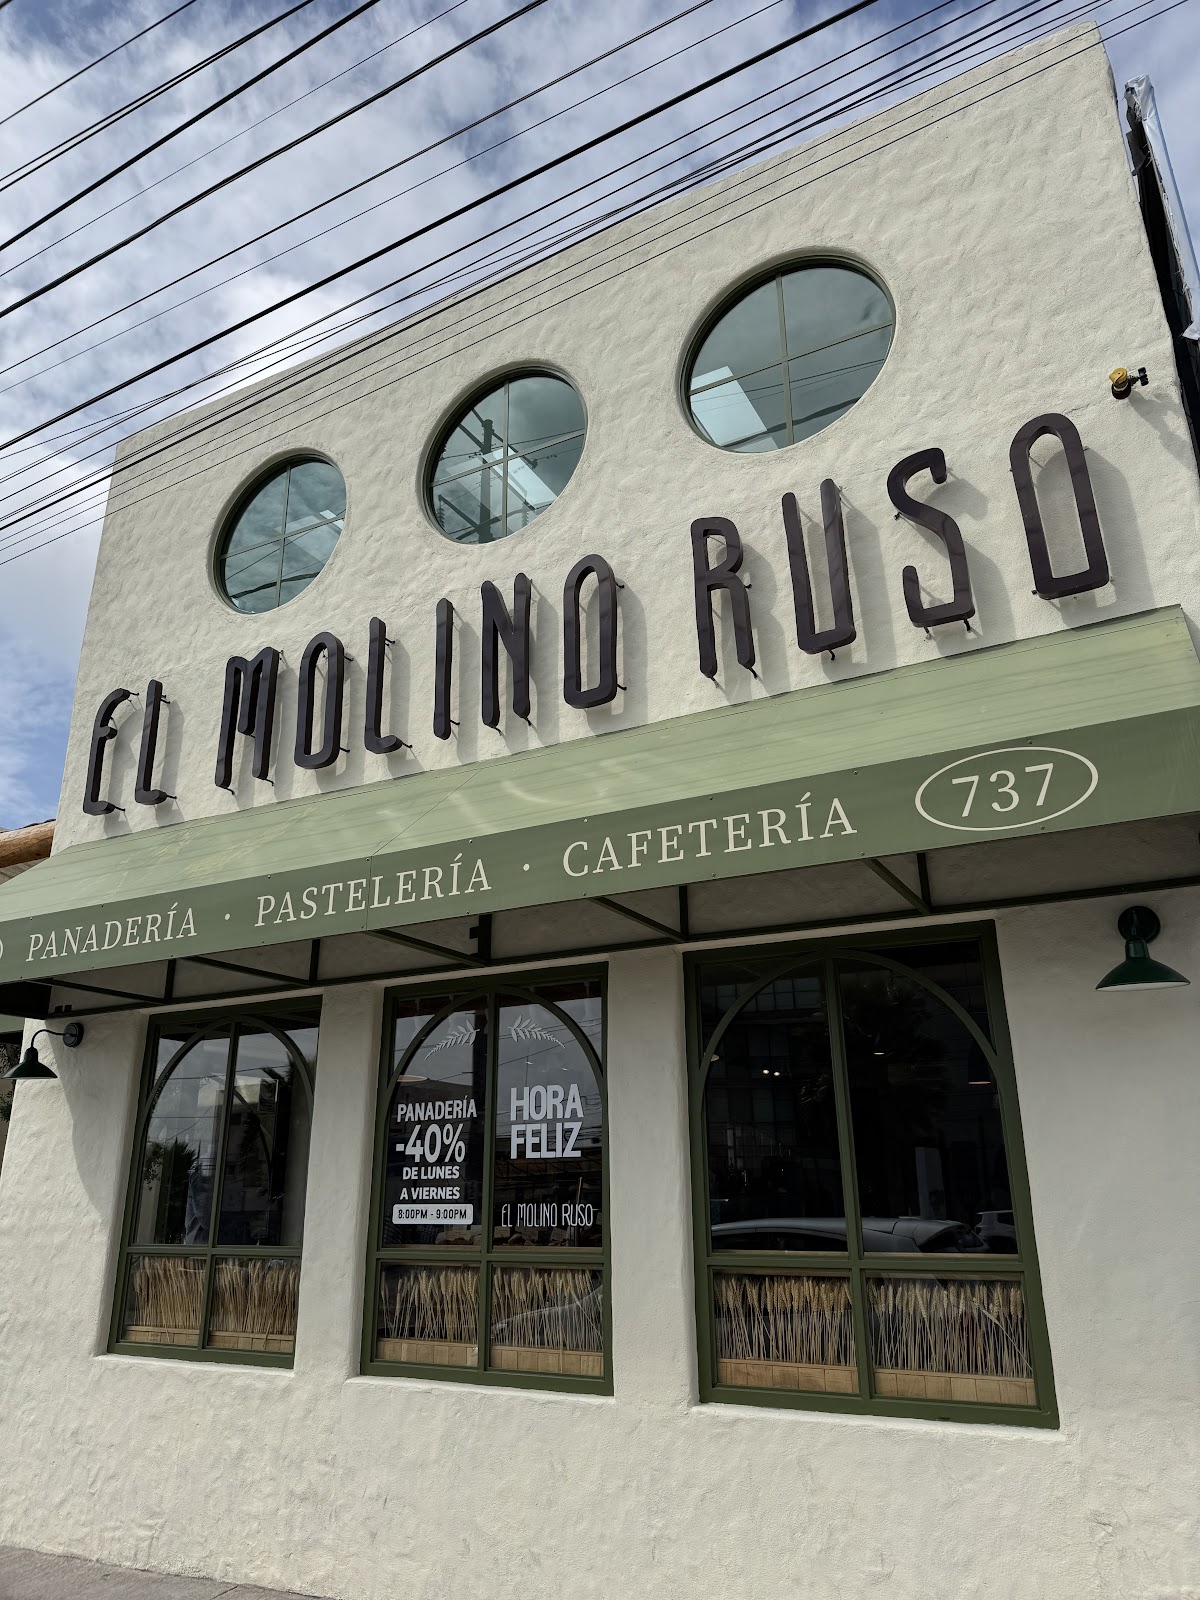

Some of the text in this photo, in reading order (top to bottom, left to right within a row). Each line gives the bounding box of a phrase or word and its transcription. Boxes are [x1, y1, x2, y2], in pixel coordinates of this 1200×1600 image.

[83, 413, 1109, 815] EL MOLINO RUSO
[951, 763, 1056, 818] 737
[25, 791, 858, 962] PANADERÍA PASTELERÍA CAFETERÍA
[397, 1096, 477, 1122] PANADERÍA
[511, 1084, 583, 1121] HORA
[396, 1124, 465, 1163] -40%
[511, 1122, 582, 1159] FELIZ
[402, 1166, 460, 1180] DE LUNES
[400, 1187, 460, 1200] A VIERNES
[397, 1209, 428, 1220] 8:00PM
[435, 1209, 467, 1219] 9:00PM
[501, 1203, 594, 1227] EL MOLINO RUSO
